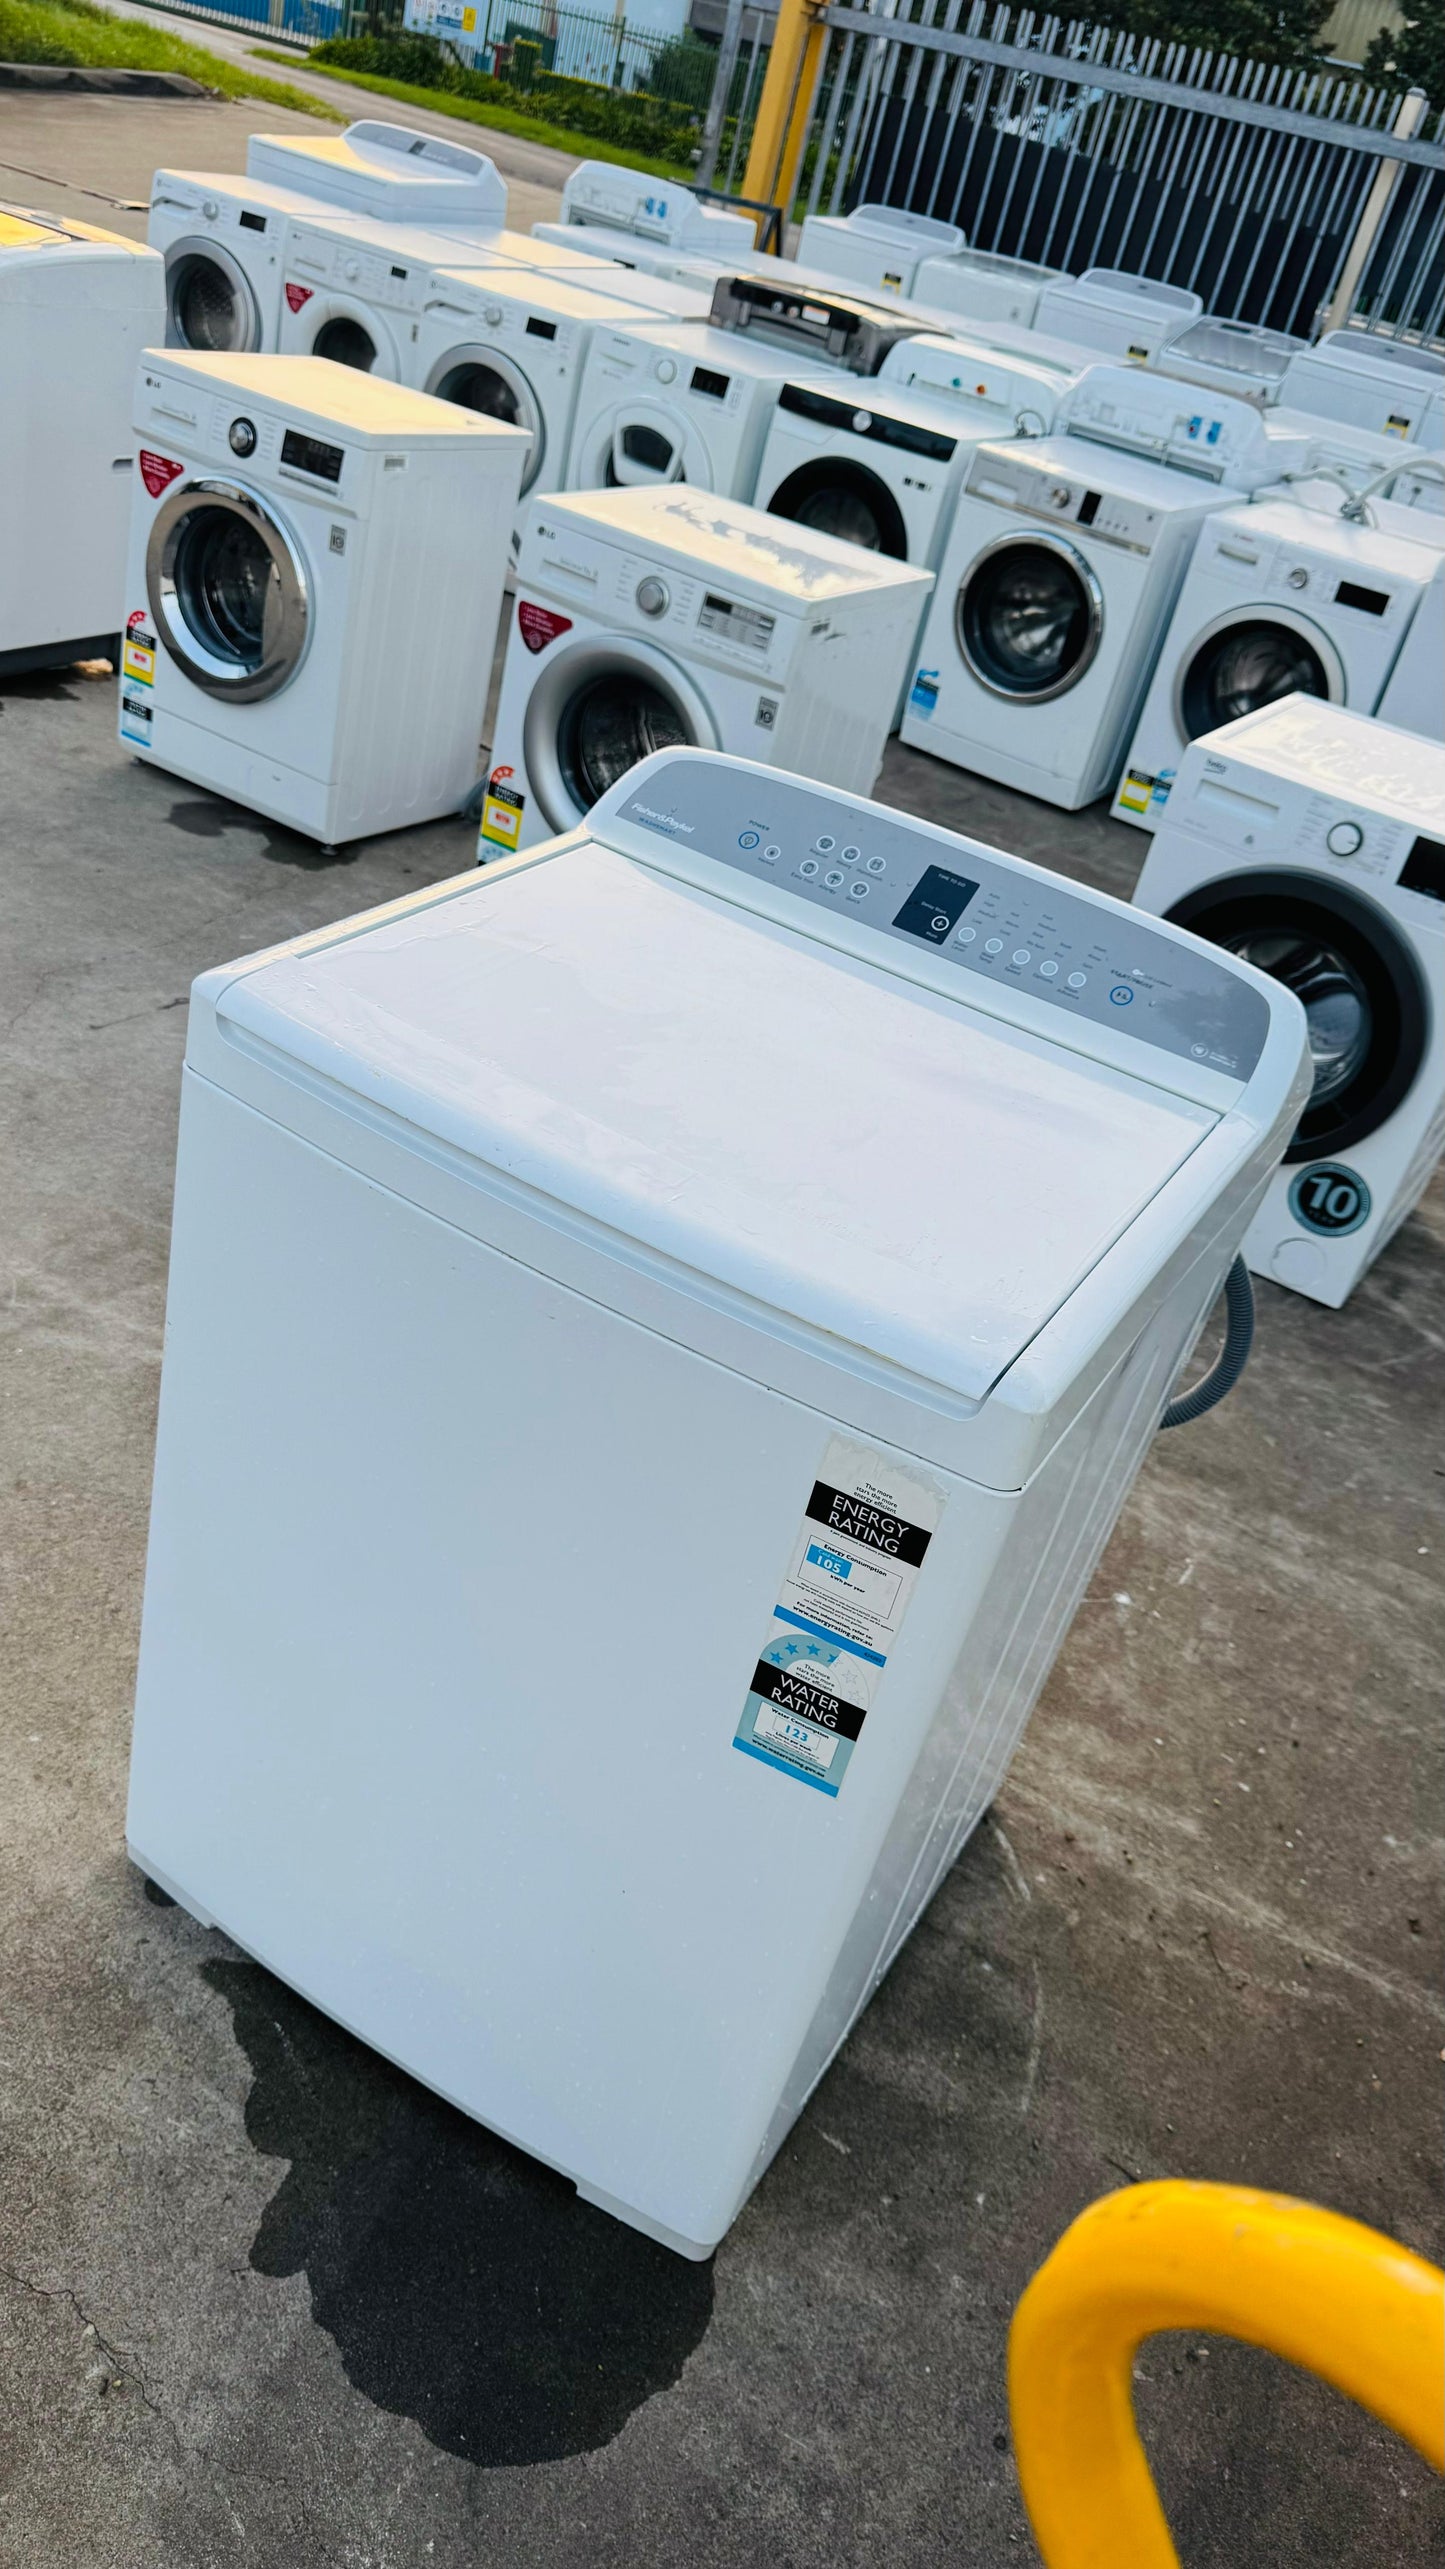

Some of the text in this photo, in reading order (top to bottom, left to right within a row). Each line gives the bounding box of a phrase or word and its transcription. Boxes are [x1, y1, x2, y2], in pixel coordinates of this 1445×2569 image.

[749, 820, 770, 831] POWER
[1310, 1177, 1359, 1219] 10
[856, 1486, 898, 1508] stars the more
[865, 1482, 894, 1500] The more
[853, 1491, 897, 1515] energy efficient
[832, 1494, 910, 1538] ENERGY
[828, 1511, 900, 1553] RATING
[816, 1555, 841, 1573] 105
[823, 1544, 888, 1577] Energy Consumption
[830, 1574, 866, 1594] kWh per year
[806, 1605, 820, 1615] more
[793, 1606, 873, 1647] www.energyrating.gov.au
[795, 1672, 833, 1692] water efficient
[796, 1666, 835, 1688] stars the more
[804, 1663, 831, 1680] The more
[781, 1674, 839, 1714] WATER
[771, 1687, 838, 1728] RATING
[771, 1707, 829, 1739] Water Consumption
[785, 1725, 808, 1742] 123
